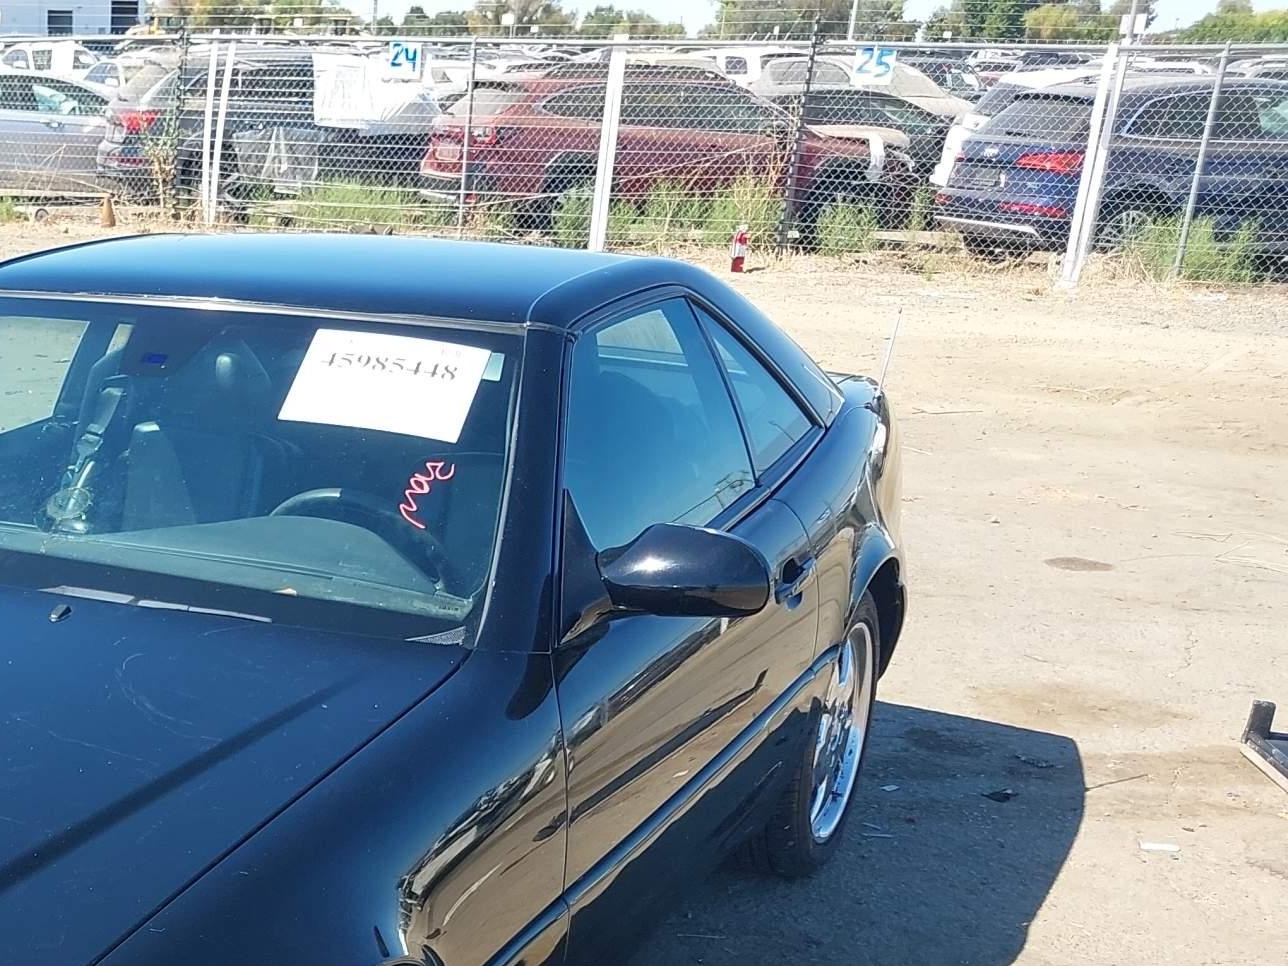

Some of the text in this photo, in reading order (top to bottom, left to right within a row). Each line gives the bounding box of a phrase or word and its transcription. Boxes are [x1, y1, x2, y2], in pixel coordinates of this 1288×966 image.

[390, 43, 417, 72] 24
[856, 47, 895, 78] 25
[321, 351, 459, 382] 45985448
